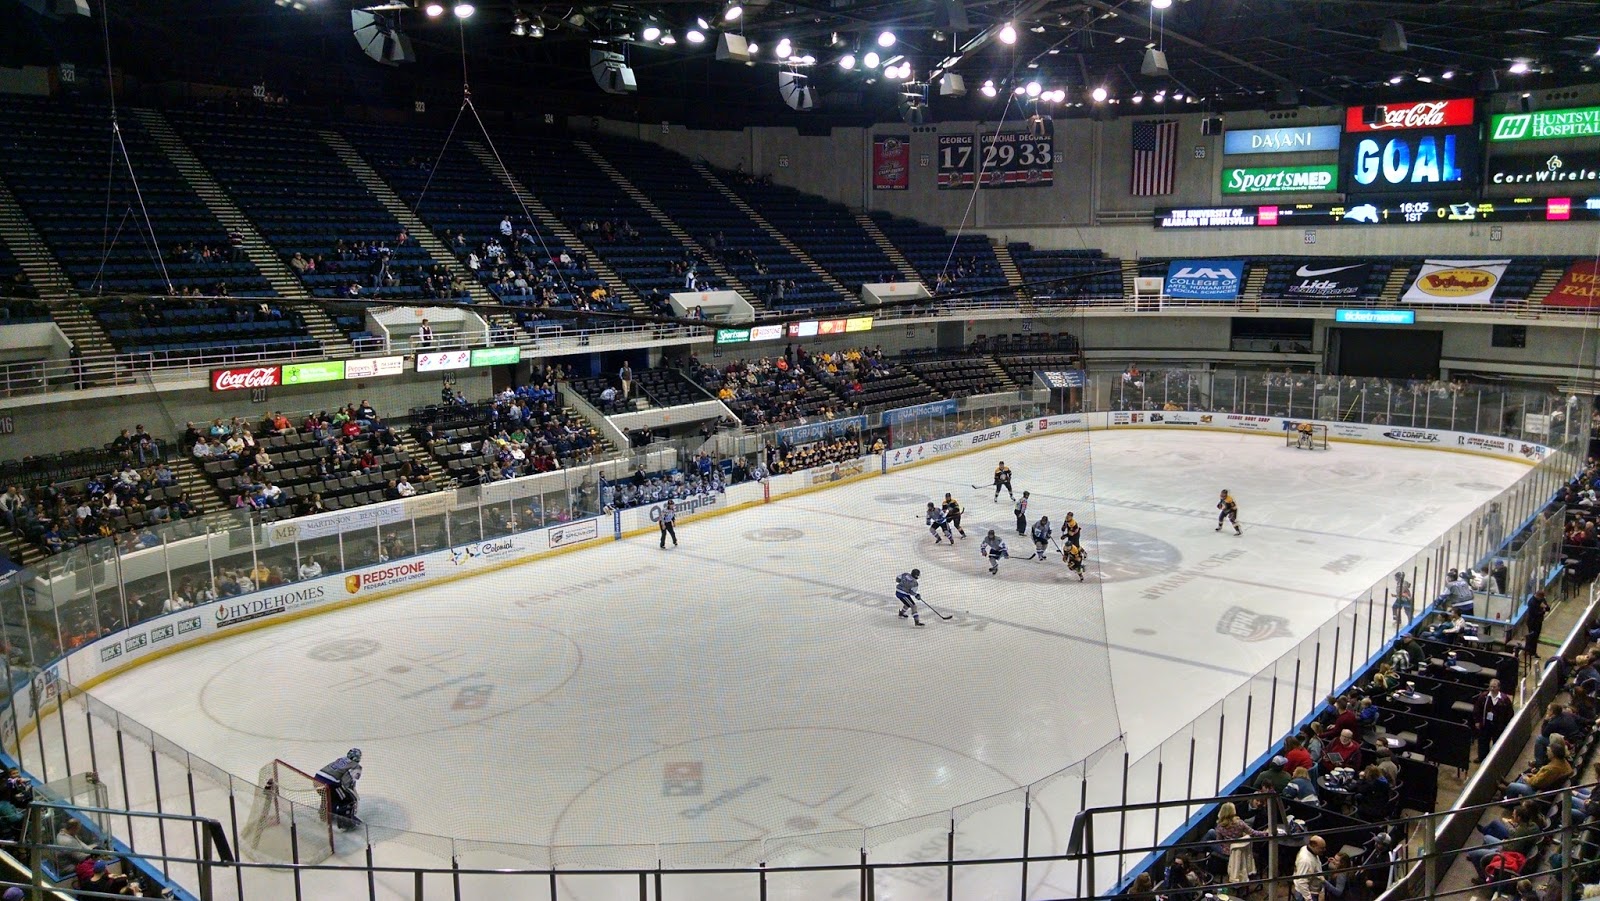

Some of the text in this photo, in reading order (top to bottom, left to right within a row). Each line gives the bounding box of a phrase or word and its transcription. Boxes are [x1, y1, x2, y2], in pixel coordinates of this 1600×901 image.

[62, 69, 75, 82] 321
[252, 85, 265, 97] 322
[415, 101, 425, 112] 323
[940, 137, 972, 145] GEORGE
[981, 135, 1016, 143] CARMICHAEL
[1252, 130, 1311, 151] DASANI
[940, 146, 972, 168] 17
[982, 145, 1014, 167] 29
[1019, 143, 1051, 165] 33
[1194, 150, 1206, 159] 329
[1354, 134, 1461, 185] GOAL
[920, 158, 929, 167] 327
[1228, 168, 1332, 192] SportsMED
[1493, 169, 1600, 184] CorrWirele
[1172, 208, 1243, 218] THE UNIVERSITY OF
[1382, 209, 1388, 219] 1
[1399, 202, 1429, 213] 16:05
[1437, 208, 1445, 217] 0
[1162, 217, 1198, 227] ALABAMA
[1199, 216, 1209, 225] IN
[1210, 216, 1254, 226] HUNTSVILLE
[1404, 213, 1422, 222] 1ST
[1304, 234, 1315, 244] 330
[1491, 231, 1502, 240] 301
[1169, 278, 1218, 286] COLLEGE
[1299, 279, 1337, 289] Lids
[1344, 311, 1406, 322] ticketmaster
[216, 366, 277, 390] Coca-Cola
[253, 388, 266, 403] 217
[0, 417, 12, 433] 16
[1401, 430, 1438, 440] COMPLEX
[307, 515, 351, 529] MARTINSON
[275, 526, 296, 540] MB
[482, 539, 514, 555] Colonial
[363, 560, 425, 585] REDSTONE
[364, 571, 426, 591] FEDERAL CREDIT UNION
[178, 618, 201, 633] DICK'S
[152, 627, 174, 642] DICK'S
[126, 636, 147, 651] DICK'S
[101, 645, 122, 660] DICK'S
